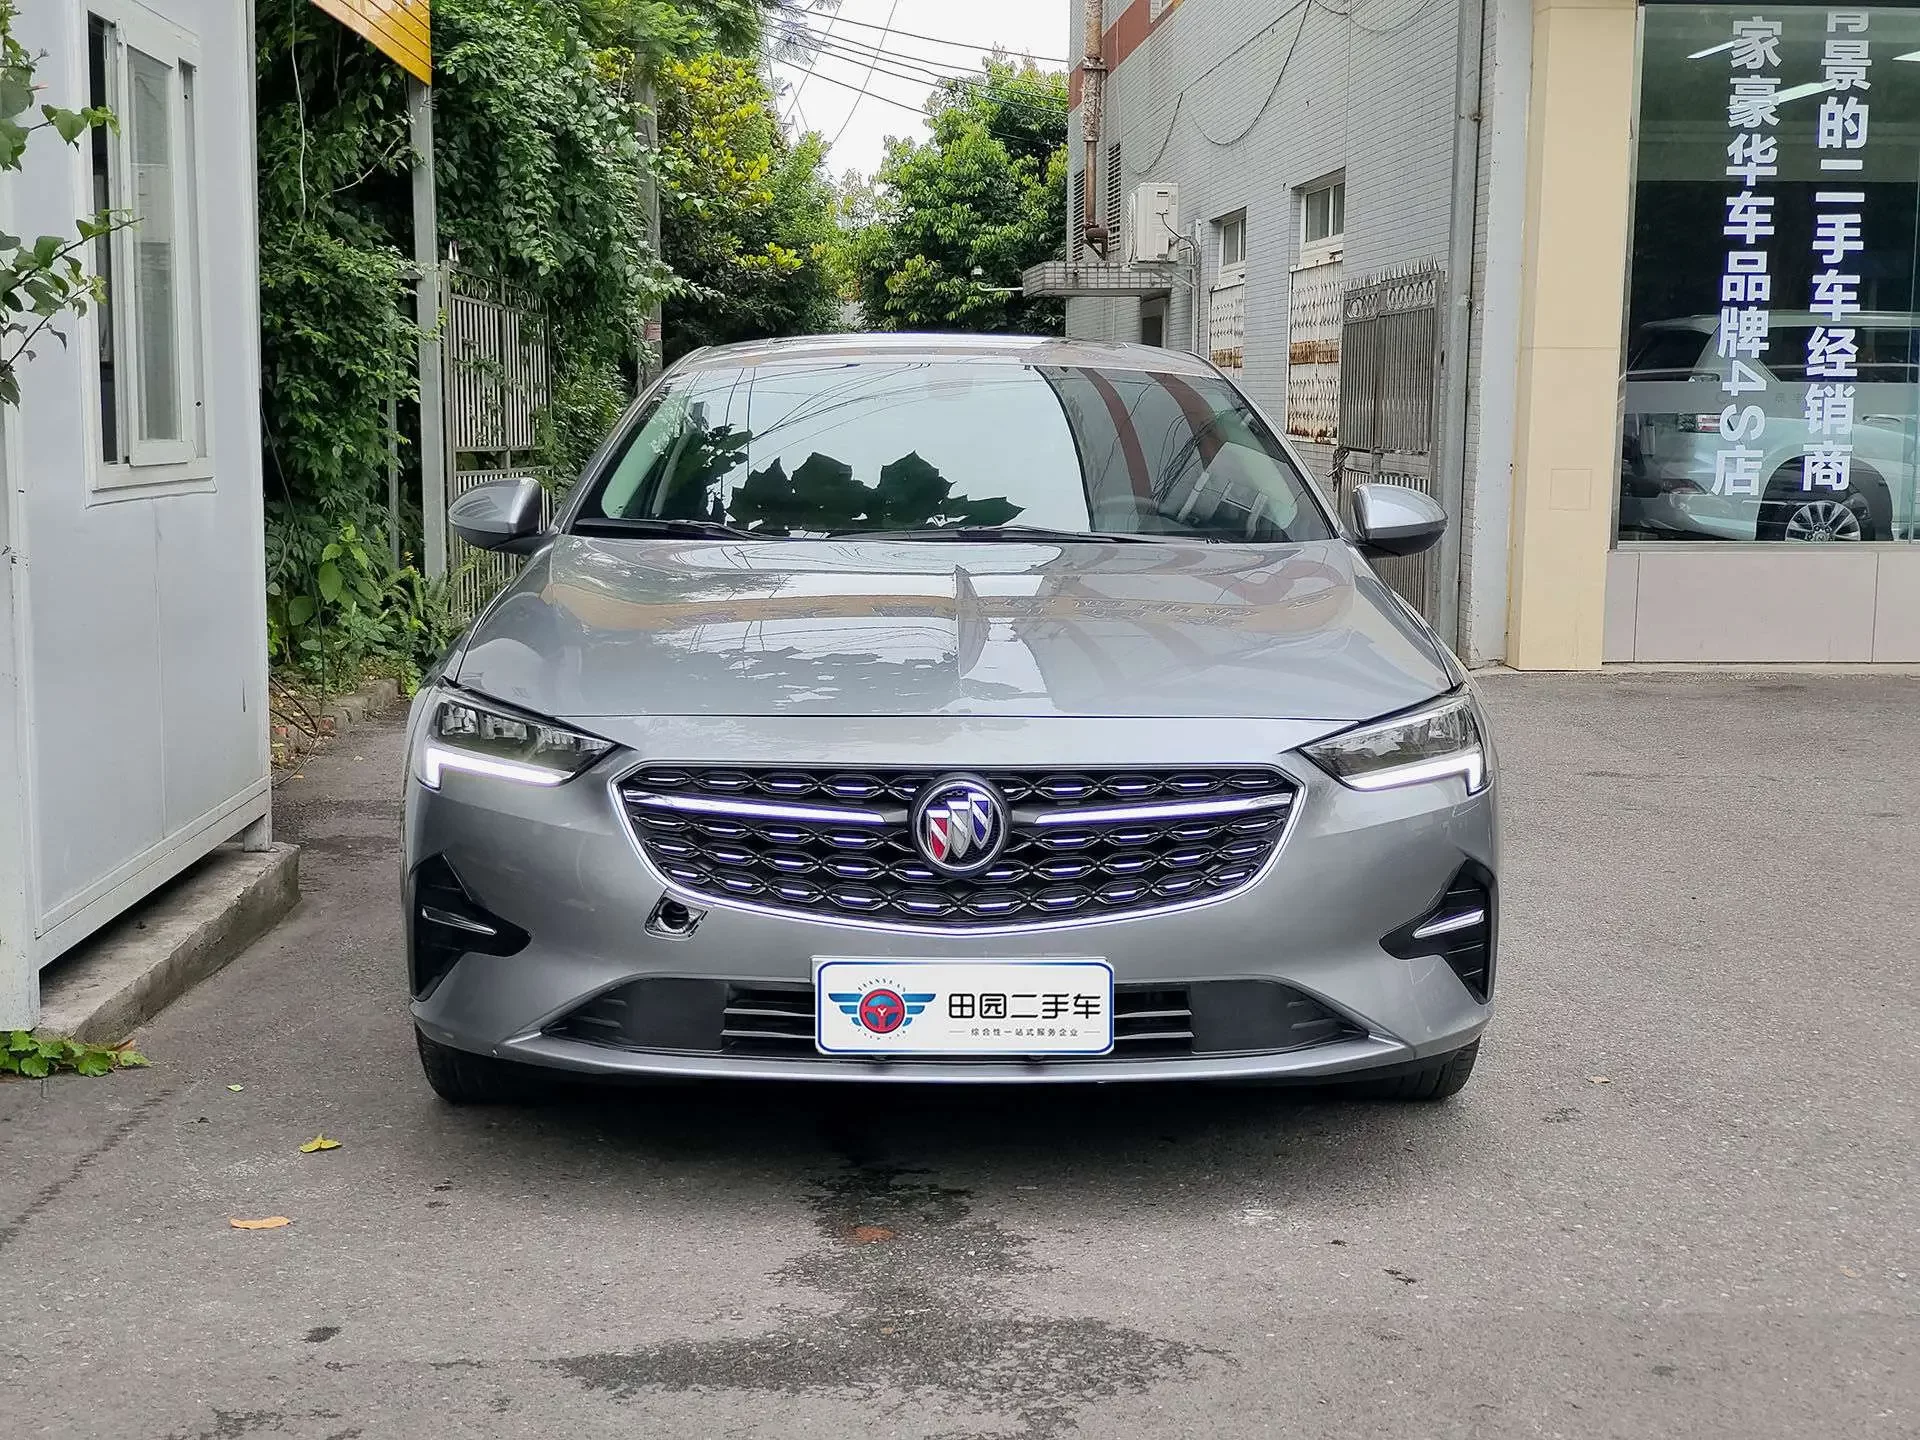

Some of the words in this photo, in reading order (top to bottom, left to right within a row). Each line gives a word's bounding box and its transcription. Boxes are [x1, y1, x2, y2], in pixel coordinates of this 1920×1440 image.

[949, 993, 1101, 1019] 田园二手车
